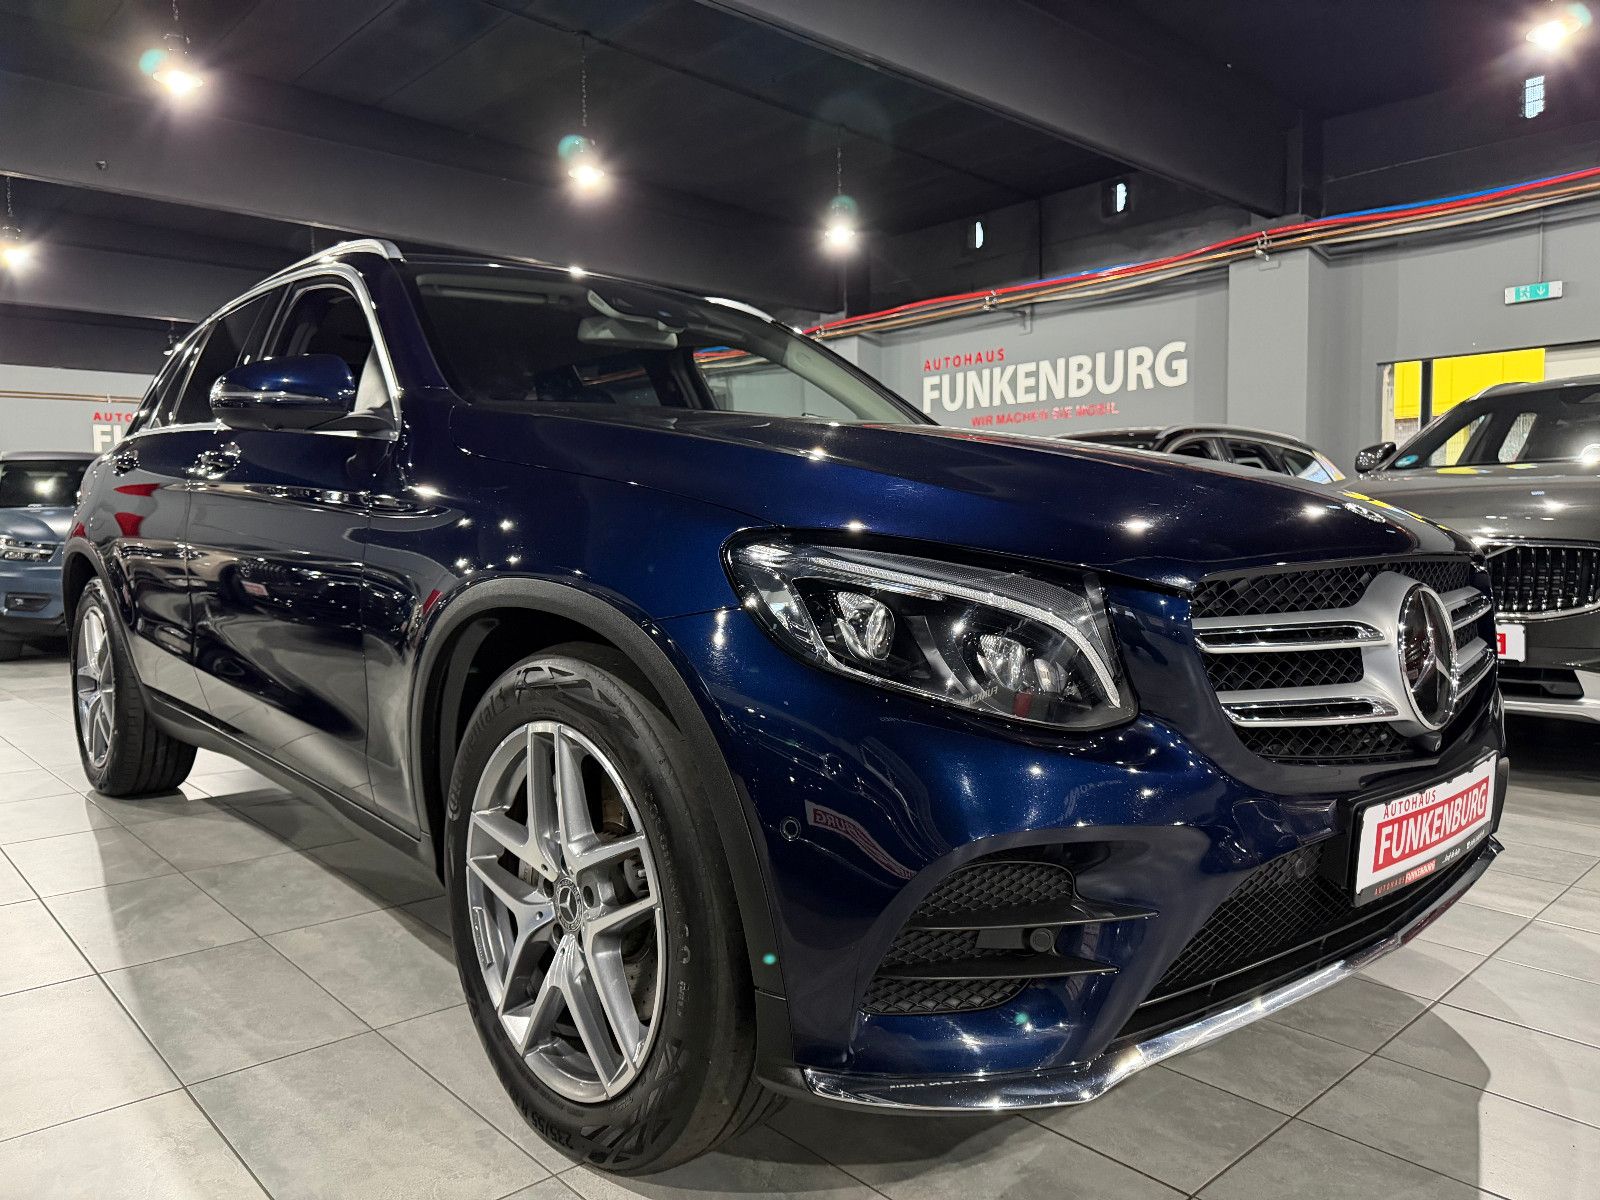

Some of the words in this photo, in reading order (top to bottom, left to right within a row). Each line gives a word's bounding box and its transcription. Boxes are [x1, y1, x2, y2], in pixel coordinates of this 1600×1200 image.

[924, 348, 1005, 371] AUTOHAUS
[922, 341, 1188, 414] FUNKENBURG
[971, 415, 993, 427] WIR
[1076, 402, 1120, 418] MOBIL
[1384, 790, 1436, 819] AUTOHAUS
[1378, 783, 1487, 865] FUNKENBURG
